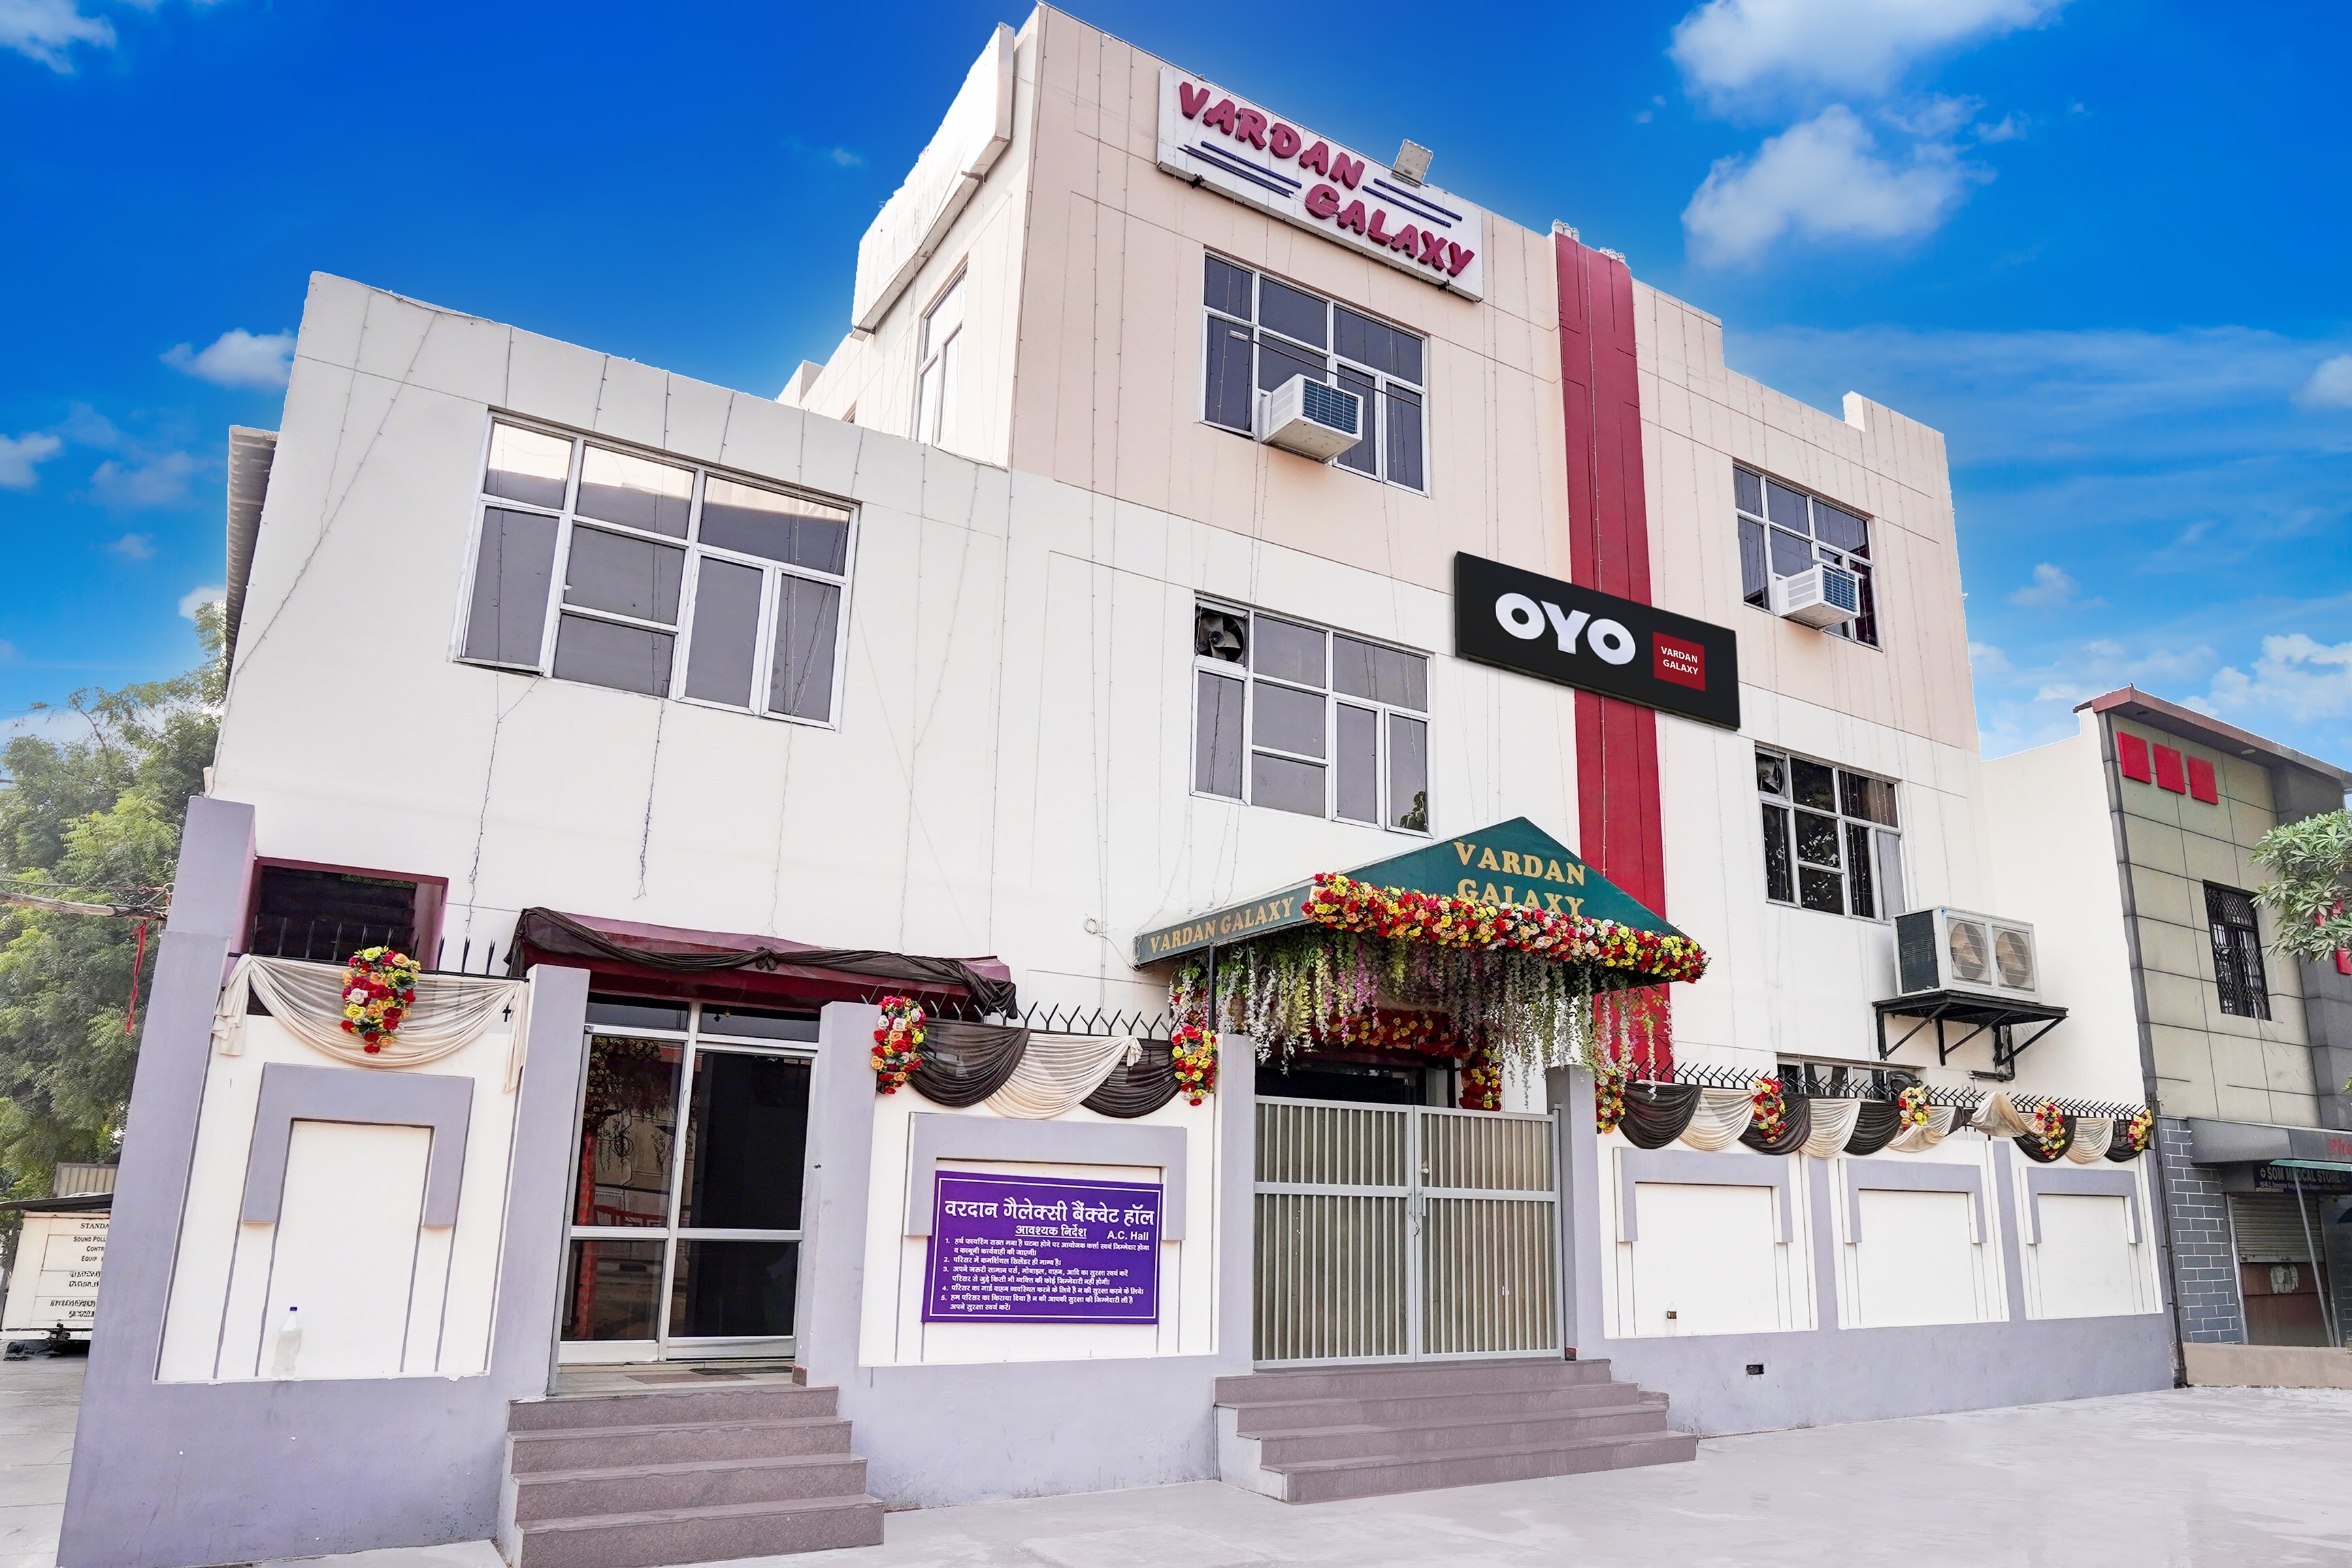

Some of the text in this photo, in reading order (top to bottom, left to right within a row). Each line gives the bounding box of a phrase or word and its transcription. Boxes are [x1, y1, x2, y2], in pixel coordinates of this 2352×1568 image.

[1179, 82, 1365, 190] VARDAN
[1305, 184, 1475, 278] GALAXY
[1495, 592, 1636, 665] OYO
[1661, 646, 1698, 664] VARDAN
[1663, 659, 1699, 675] GALAXY
[1454, 842, 1585, 886] VARDAN
[1149, 896, 1294, 953] VARDAN GALAXY
[945, 1197, 1155, 1226] वरदान गैलेक्सी बैंक्वेट हॉल
[1015, 1224, 1088, 1237] आवश्यक निर्देश
[1107, 1230, 1149, 1241] A.C. Hall
